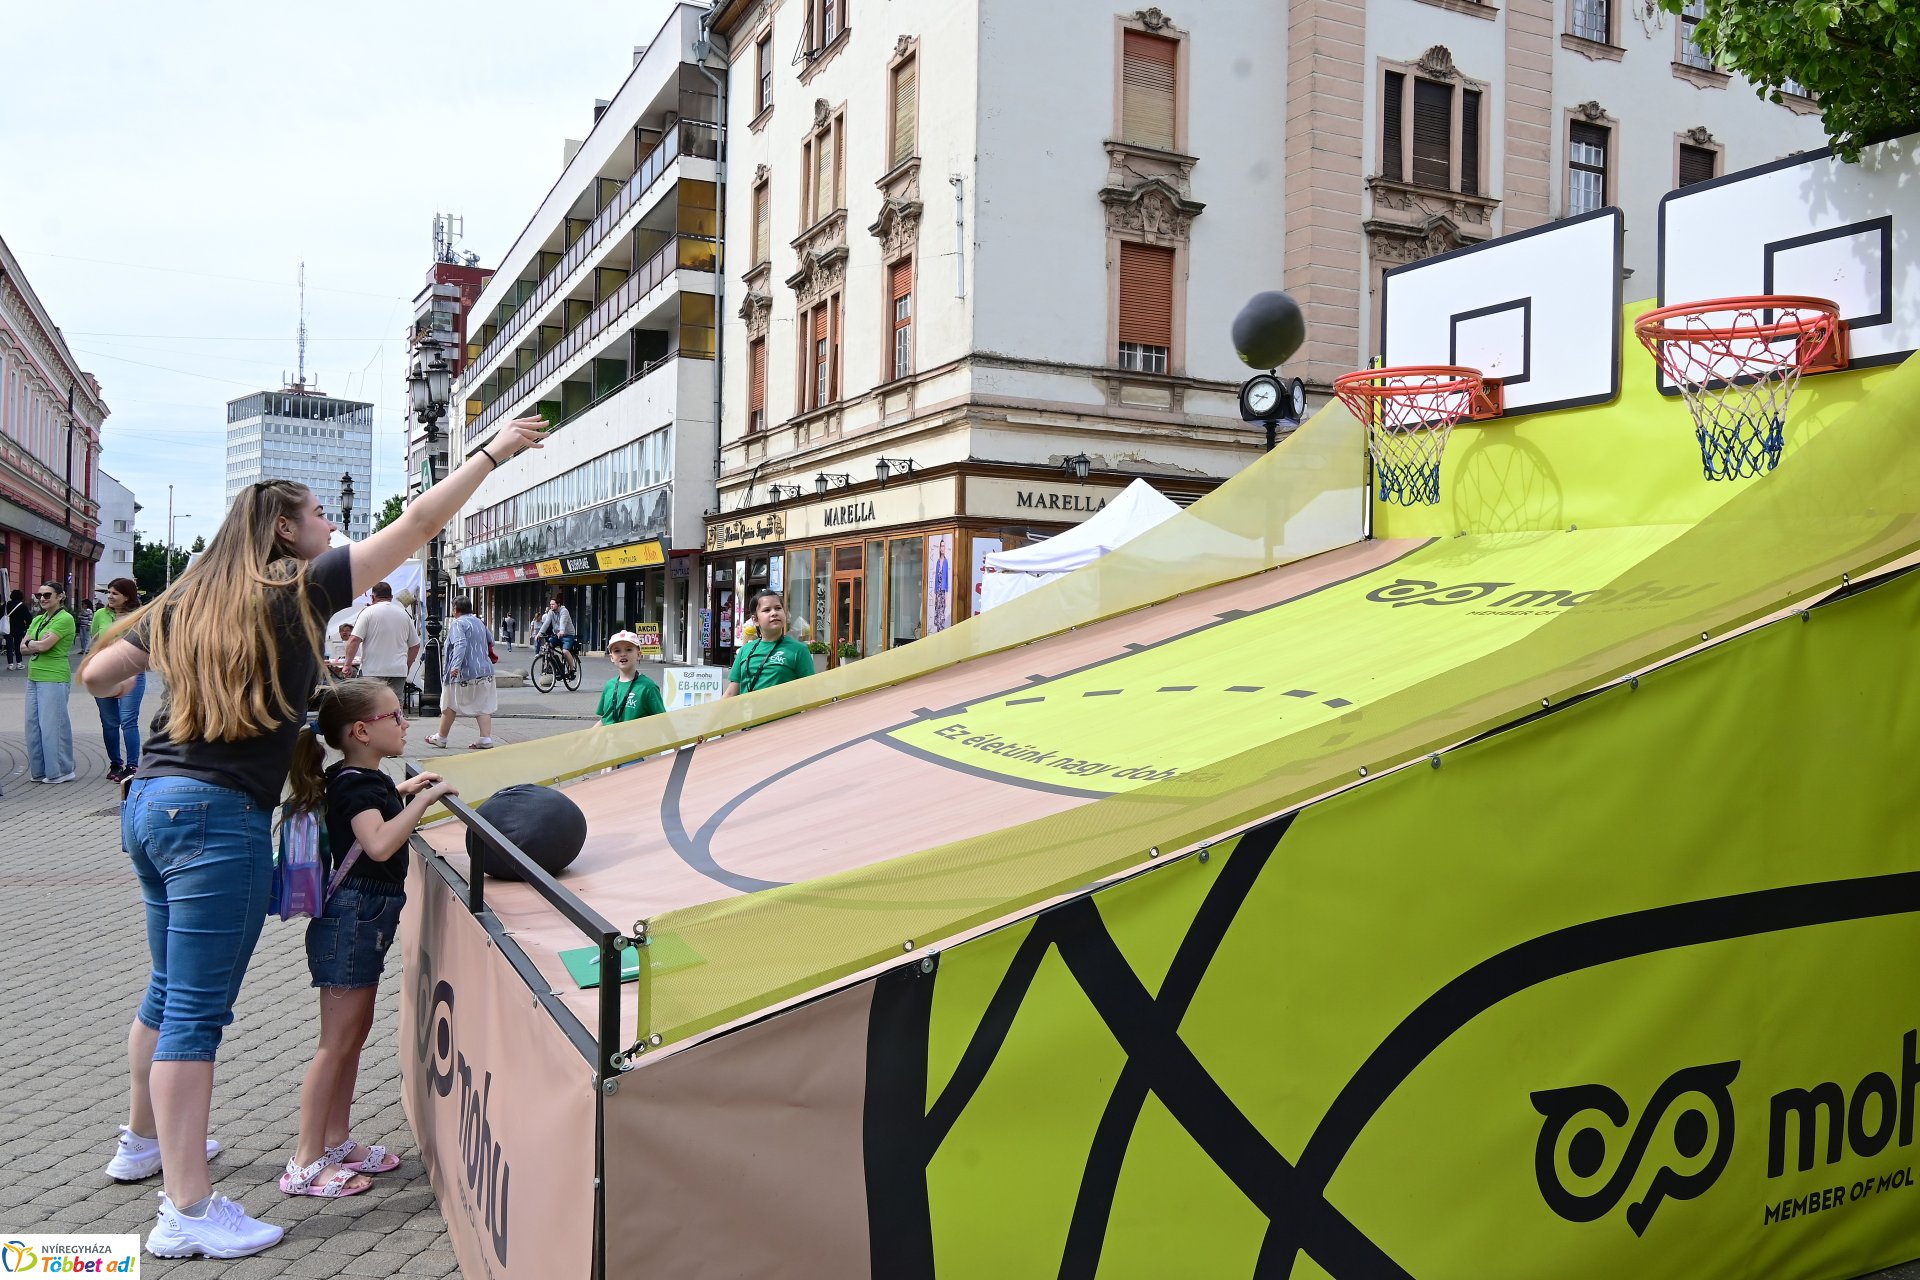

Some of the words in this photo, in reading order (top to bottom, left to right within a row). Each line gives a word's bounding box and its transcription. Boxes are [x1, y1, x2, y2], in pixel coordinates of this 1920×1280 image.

[1017, 490, 1107, 512] MARELLA
[824, 501, 876, 528] MARELLA
[638, 623, 657, 632] AKCIÓ
[678, 681, 719, 691] EB-KAPU
[696, 671, 713, 679] mohu
[932, 723, 971, 741] Ez
[961, 733, 1060, 765] életünk
[1045, 756, 1121, 777] nagy
[456, 1049, 510, 1269] mohu
[1764, 1186, 1846, 1226] MEMBER
[1850, 1178, 1876, 1202] OF
[1876, 1166, 1914, 1194] MOL
